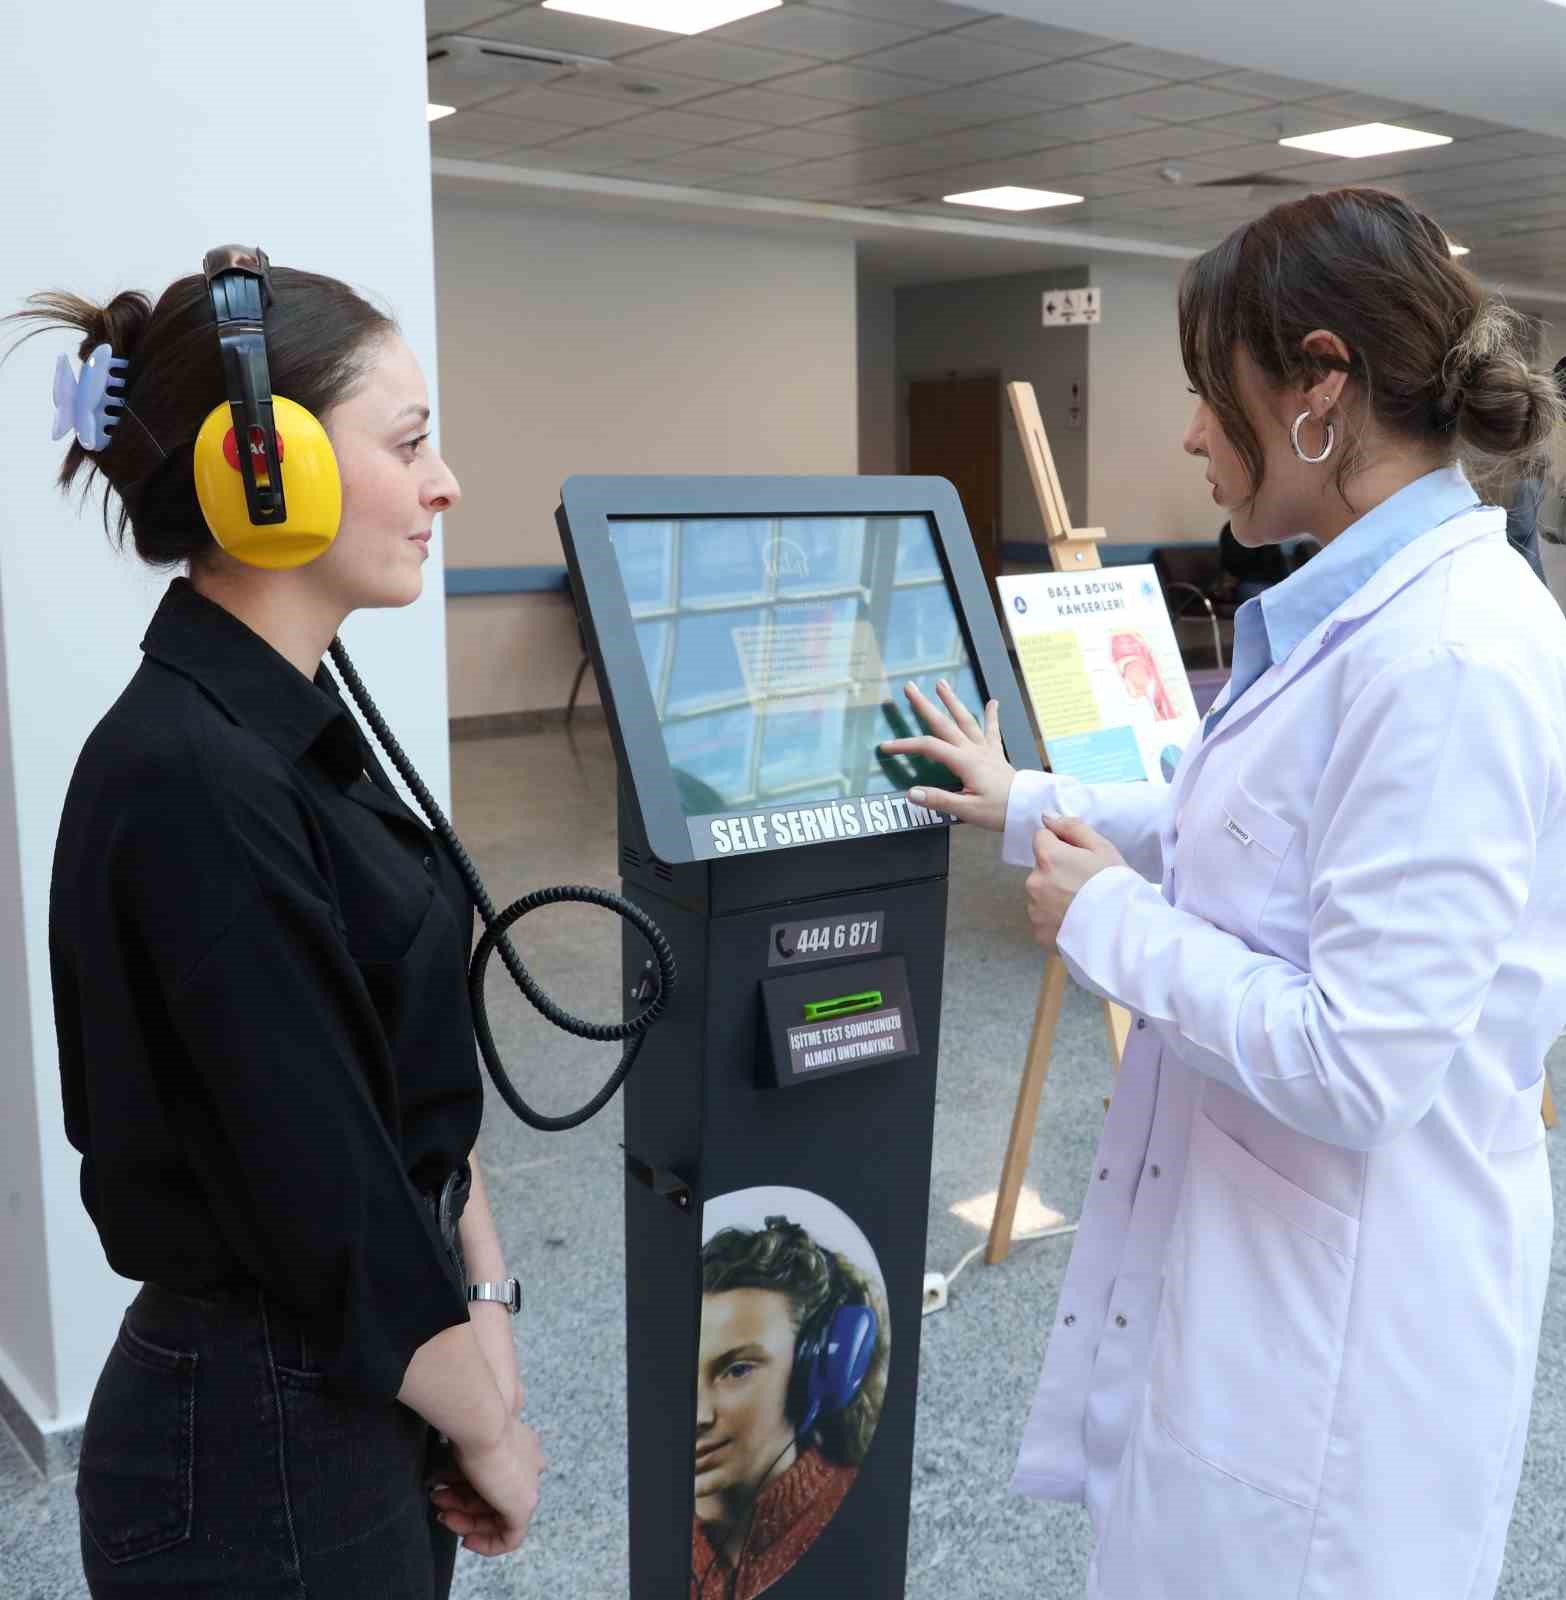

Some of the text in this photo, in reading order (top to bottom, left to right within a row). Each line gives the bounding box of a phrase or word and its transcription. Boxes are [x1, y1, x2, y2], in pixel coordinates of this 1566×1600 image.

[1085, 581, 1124, 595] BOYUN
[711, 815, 768, 852] SELF
[772, 801, 859, 846] SERVİS
[797, 920, 878, 952] 444 6 871
[790, 1015, 901, 1050] İŞİTME TEST SONUCUNUZU
[804, 1037, 894, 1068] ALMAYI UNUTMAYINIZ
